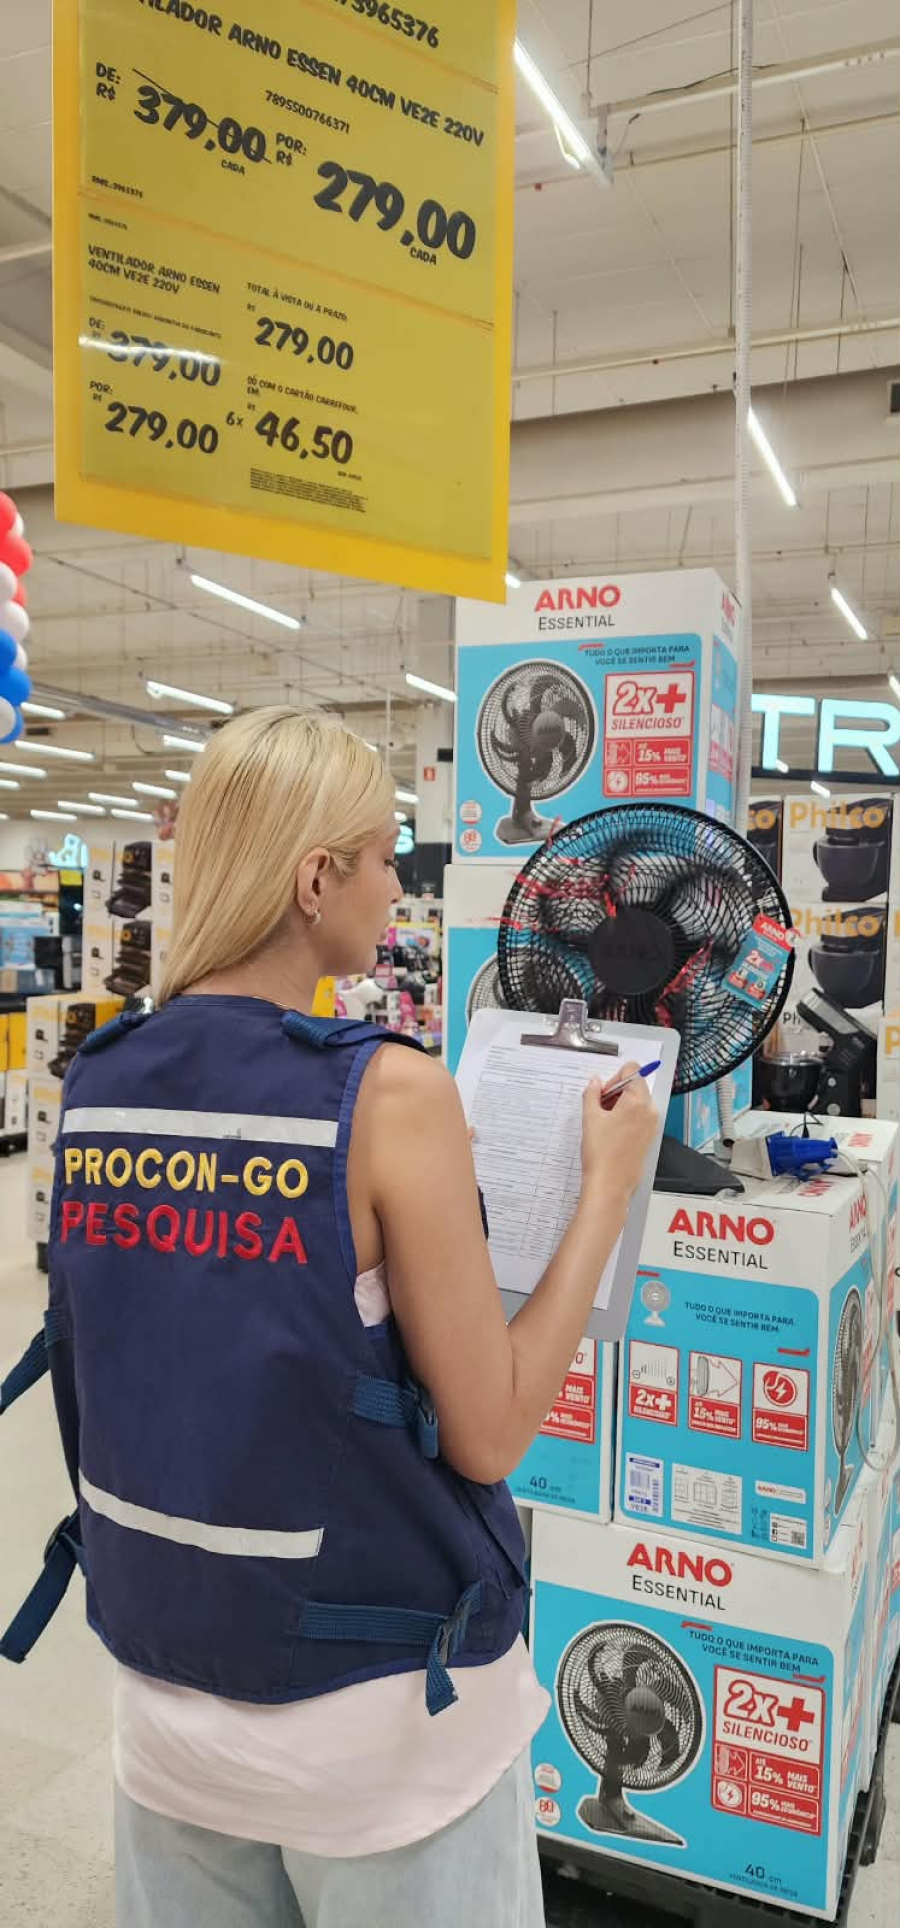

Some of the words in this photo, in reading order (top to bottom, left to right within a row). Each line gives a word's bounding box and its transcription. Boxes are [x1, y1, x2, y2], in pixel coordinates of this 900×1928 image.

[96, 62, 121, 84] DE:
[228, 23, 282, 60] ARNO
[287, 48, 342, 86] ESSEN
[346, 75, 396, 110] 40CM
[400, 96, 441, 128] VE2E
[443, 117, 484, 147] 220V
[96, 82, 117, 101] R$
[264, 90, 350, 136] 7895500766371
[275, 132, 307, 156] POR:
[221, 159, 246, 176] CADA
[276, 150, 294, 167] R$
[313, 160, 476, 260] 279,00
[410, 246, 438, 266] CADA
[88, 244, 155, 274] VENTILADOR
[158, 265, 188, 284] ARNO
[190, 275, 220, 295] ESSEN
[88, 258, 121, 277] 40CM
[123, 267, 150, 285] VE2E
[153, 277, 180, 295] 220V
[247, 282, 271, 297] TOTAL
[281, 293, 303, 308] VISTA
[254, 316, 354, 371] 279,00
[89, 380, 113, 395] POR:
[259, 380, 277, 392] COM
[285, 387, 315, 402] CARTÃO
[105, 401, 219, 454] 279,00
[255, 410, 354, 465] 46,50
[534, 584, 621, 612] ARNO
[538, 613, 616, 632] ESSENTIAL
[614, 646, 630, 655] QUE
[658, 655, 676, 663] BEM
[611, 717, 684, 731] SILENCIOSO
[789, 800, 886, 830] Philco
[64, 1147, 309, 1199] PROCON-GO
[60, 1200, 308, 1265] PESQUISA
[668, 1208, 775, 1246] ARNO
[673, 1240, 768, 1270] ESSENTIAL
[685, 1302, 707, 1312] TUDO
[716, 1306, 732, 1316] QUE
[733, 1310, 770, 1321] IMPORTA
[771, 1315, 794, 1326] PARA
[718, 1316, 729, 1325] SE
[730, 1318, 759, 1330] SENTIR
[760, 1322, 779, 1333] BEM
[530, 1475, 548, 1490] 40
[626, 1542, 733, 1588] ARNO
[632, 1573, 726, 1612] ESSENTIAL
[689, 1630, 715, 1643] TUDO
[716, 1636, 724, 1645] O
[725, 1638, 745, 1650] QUE
[747, 1641, 790, 1661] IMPORTA
[792, 1651, 819, 1667] PARA
[701, 1643, 727, 1657] VOCÊ
[730, 1650, 741, 1661] SE
[742, 1651, 777, 1668] SENTIR
[780, 1659, 801, 1676] BEM
[723, 1720, 809, 1753] SILENCIOSO
[754, 1764, 784, 1785] 15%
[786, 1779, 815, 1794] VENTO
[787, 1770, 809, 1783] MAIS
[751, 1791, 781, 1812] 95%
[745, 1863, 766, 1879] 40
